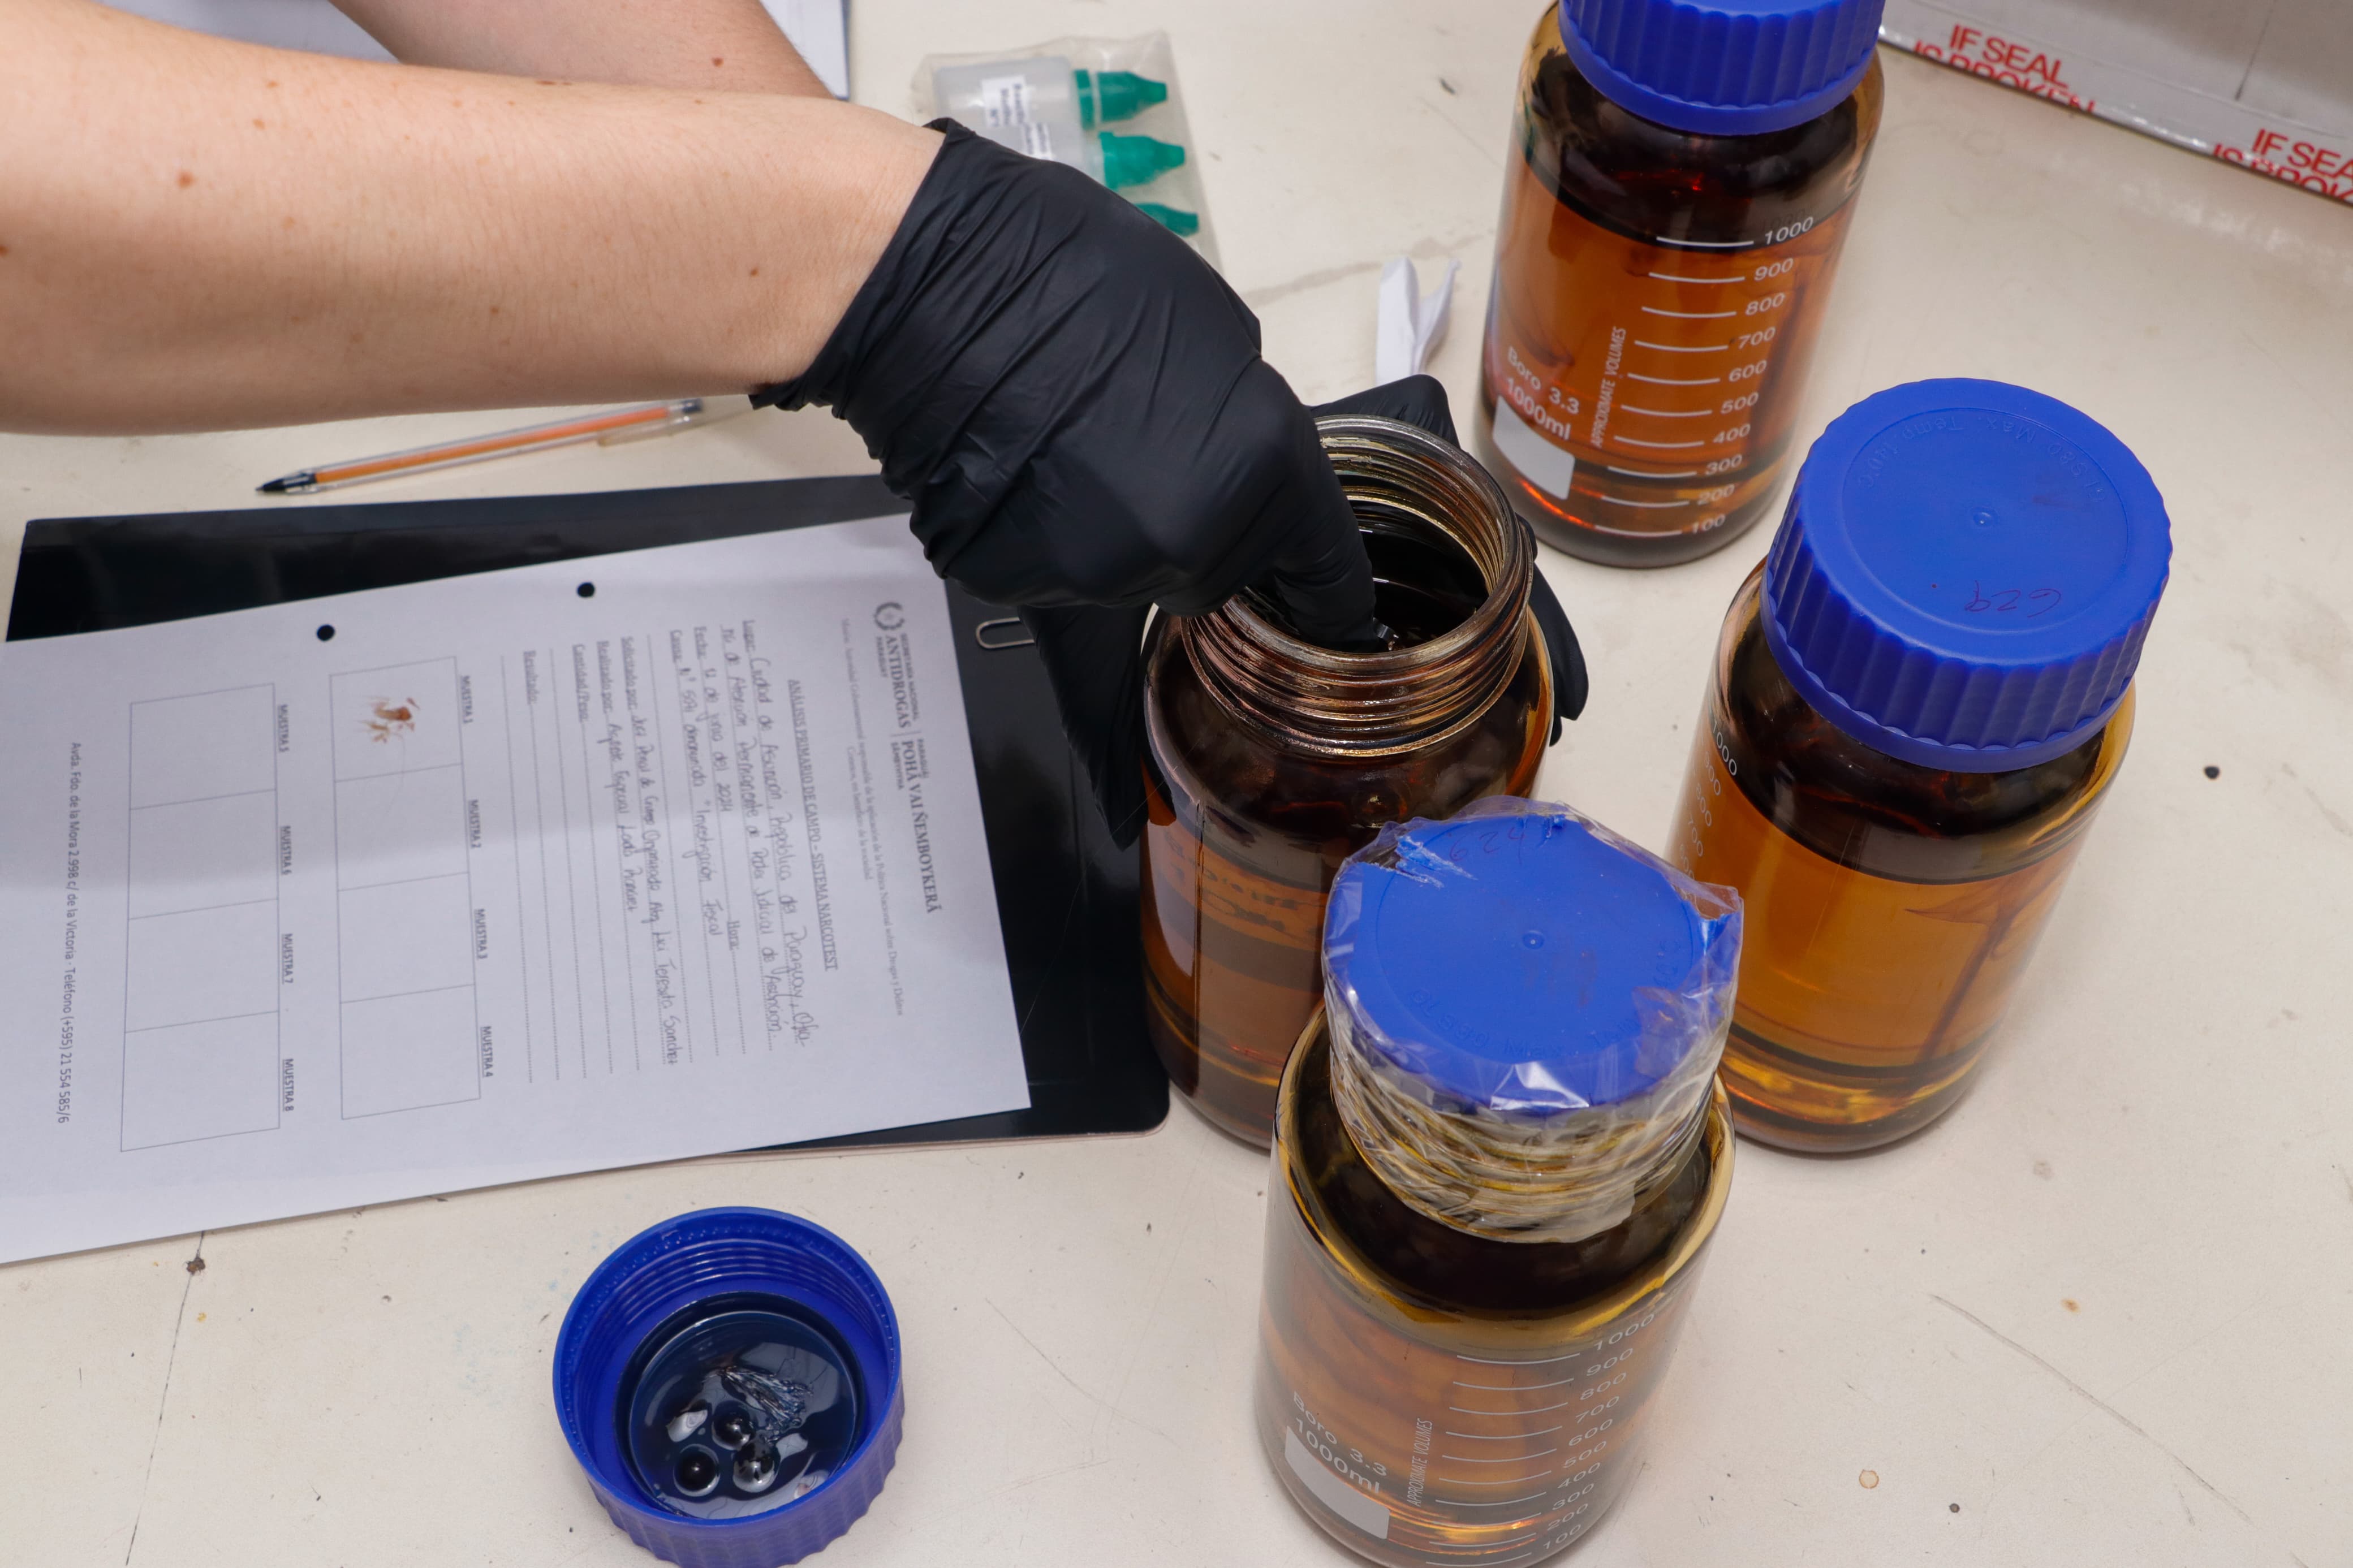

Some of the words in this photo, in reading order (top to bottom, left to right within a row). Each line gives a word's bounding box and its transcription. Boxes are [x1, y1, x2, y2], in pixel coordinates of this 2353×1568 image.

[1950, 24, 1981, 51] IF
[1983, 37, 2069, 89] SEAL
[2252, 128, 2288, 155] IF
[1765, 217, 1813, 245] 1000
[1755, 258, 1794, 280] 900
[1746, 292, 1785, 316] 800
[1738, 327, 1776, 349] 700
[1508, 346, 1541, 390] Boro
[1549, 387, 1579, 414] 3.3
[1728, 360, 1768, 383] 600
[1591, 378, 1615, 448] APPROXIMATE
[1605, 326, 1627, 375] VOLUMES
[1507, 377, 1571, 440] 1000ml
[1720, 392, 1759, 414] 500
[1713, 424, 1751, 446] 400
[1705, 455, 1743, 476] 300
[1697, 485, 1735, 506] 200
[1692, 515, 1726, 534] 100
[885, 634, 911, 728] ANTIDROGAS
[460, 675, 473, 717] MUESTRA
[706, 688, 719, 703] de
[788, 680, 806, 727] ANÁLISIS
[278, 704, 288, 745] MUESTRA
[759, 715, 774, 731] de
[70, 742, 82, 769] Avda.
[795, 729, 815, 784] PRIMARIO
[1713, 721, 1737, 776] 1000
[70, 772, 82, 793] Fdo.
[804, 787, 816, 803] DE
[908, 784, 924, 809] VAI
[69, 795, 81, 807] de
[69, 810, 81, 819] la
[68, 821, 80, 848] Mora
[468, 800, 481, 841] MUESTRA
[805, 803, 822, 843] CAMPO
[281, 826, 292, 868] MUESTRA
[67, 850, 80, 878] 2.998
[811, 853, 829, 902] SISTEMA
[65, 882, 79, 891] c/
[67, 894, 79, 906] de
[66, 909, 78, 918] la
[880, 892, 892, 926] Nacional
[64, 921, 77, 960] Victoria
[475, 909, 487, 952] MUESTRA
[727, 921, 741, 951] Hora:
[817, 903, 838, 971] NARCOTEST
[884, 928, 896, 949] sobre
[282, 933, 294, 976] MUESTRA
[886, 951, 899, 980] Drogas
[62, 968, 76, 1014] Teléfono
[893, 987, 904, 1016] Delitos
[58, 1016, 75, 1050] (+595)
[60, 1053, 73, 1065] 21
[481, 1026, 493, 1070] MUESTRA
[59, 1068, 72, 1088] 554
[283, 1059, 294, 1104] MUESTRA
[56, 1091, 71, 1124] 585/6
[1594, 1314, 1654, 1351] 1000
[1586, 1347, 1634, 1377] 900
[1580, 1372, 1627, 1401] 800
[1575, 1396, 1619, 1424] 700
[1294, 1391, 1337, 1444] Boro
[1350, 1448, 1387, 1476] 3.3
[1413, 1418, 1433, 1455] VOLUMES
[1568, 1419, 1613, 1446] 600
[1296, 1418, 1380, 1493] 1000ml
[1563, 1440, 1607, 1468] 500
[1407, 1455, 1428, 1507] APPROXIMATE
[1557, 1462, 1601, 1489] 400
[1552, 1483, 1594, 1511] 300
[1547, 1503, 1588, 1531] 200
[1544, 1524, 1581, 1550] 100
